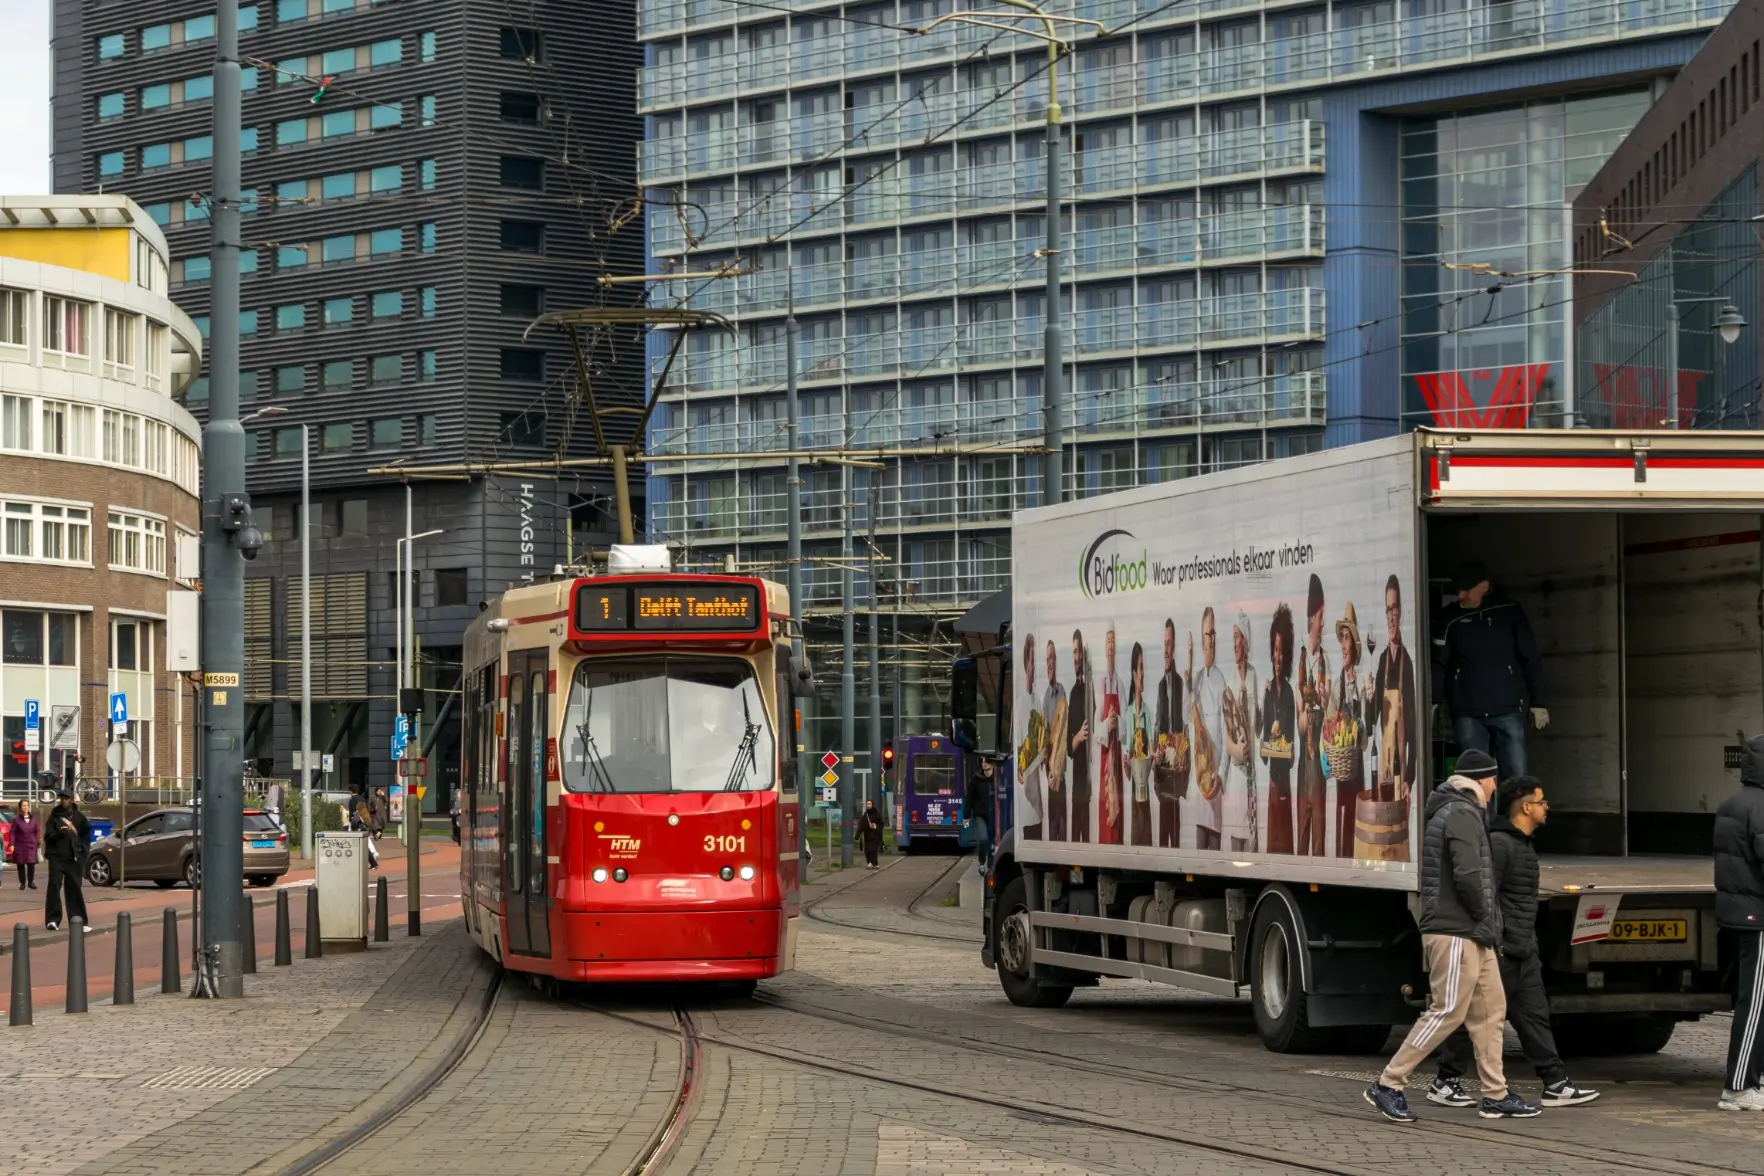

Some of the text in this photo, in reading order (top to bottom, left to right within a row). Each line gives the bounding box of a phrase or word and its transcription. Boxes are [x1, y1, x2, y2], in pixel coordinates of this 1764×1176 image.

[520, 483, 534, 566] HAAGSE
[1094, 549, 1147, 596] Bidfood
[1152, 538, 1314, 591] Waar professionals elkaar vinden
[600, 597, 748, 619] 1 Delft Tanthof
[206, 675, 236, 685] M5899
[28, 702, 37, 718] P
[610, 839, 641, 850] HTM
[703, 835, 745, 853] 3101
[1612, 922, 1679, 938] 09-BJK-1
